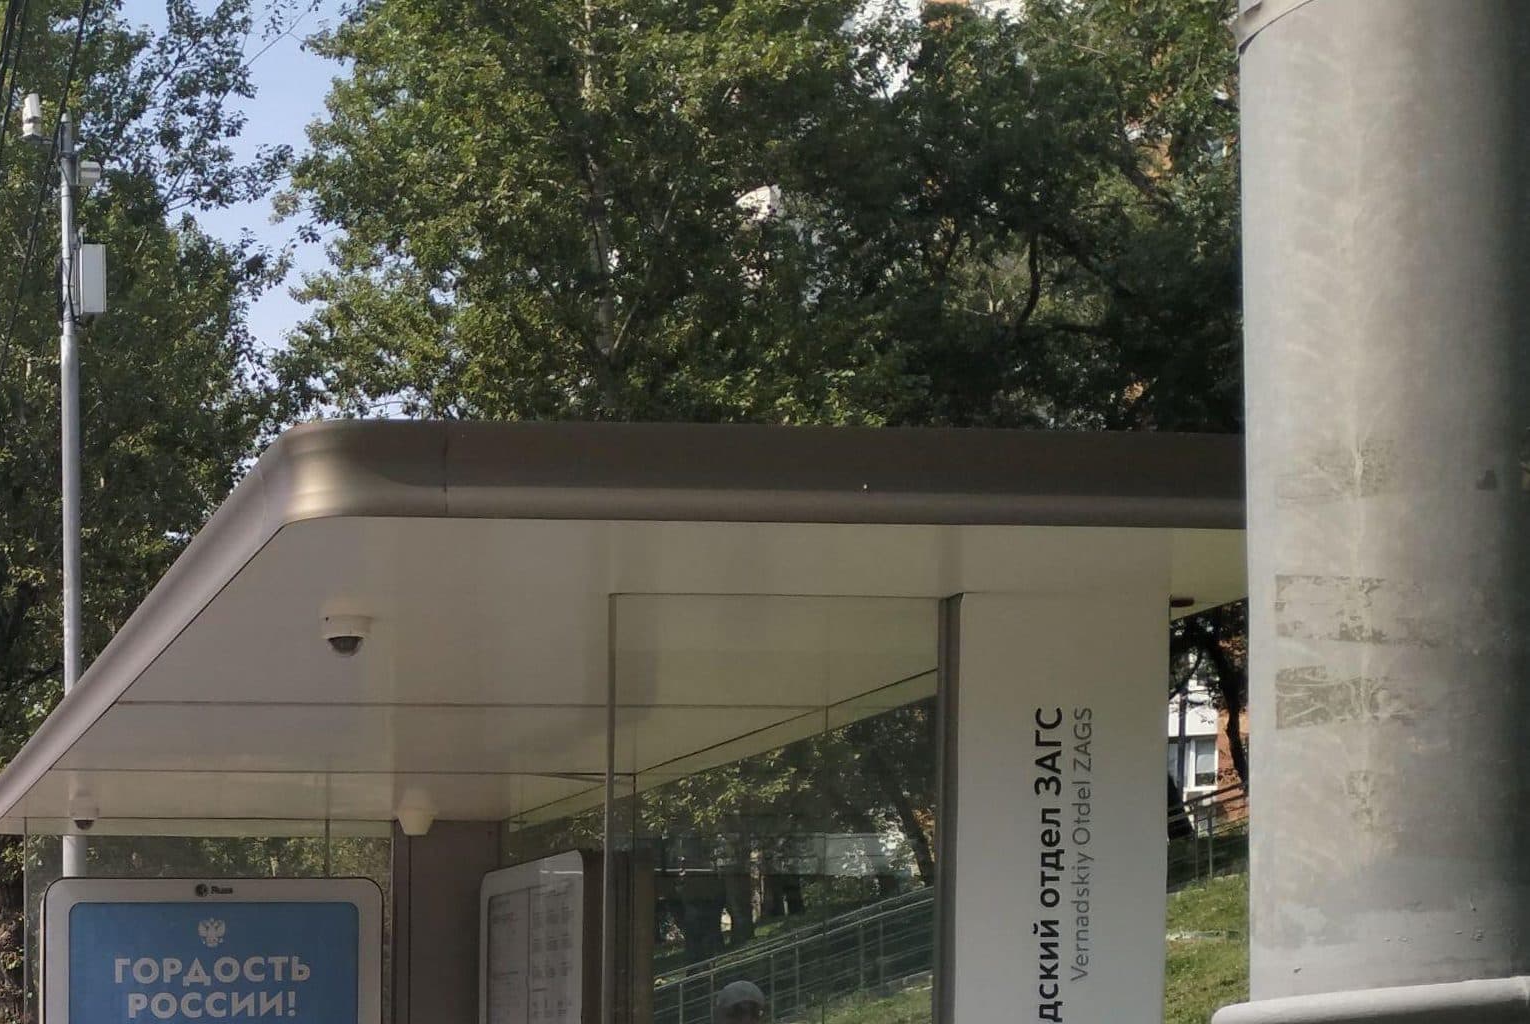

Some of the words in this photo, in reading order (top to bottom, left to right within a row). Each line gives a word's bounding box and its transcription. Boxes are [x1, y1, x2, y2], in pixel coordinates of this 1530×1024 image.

[1034, 708, 1062, 796] ЗАГС
[1073, 708, 1092, 772] ZAGS
[1071, 781, 1091, 845] Otdel
[1040, 808, 1065, 908] отдел
[1070, 852, 1095, 981] Vernadskiy
[114, 955, 311, 987] ГОРДОСТЬ
[127, 991, 297, 1019] РОССИИ!
